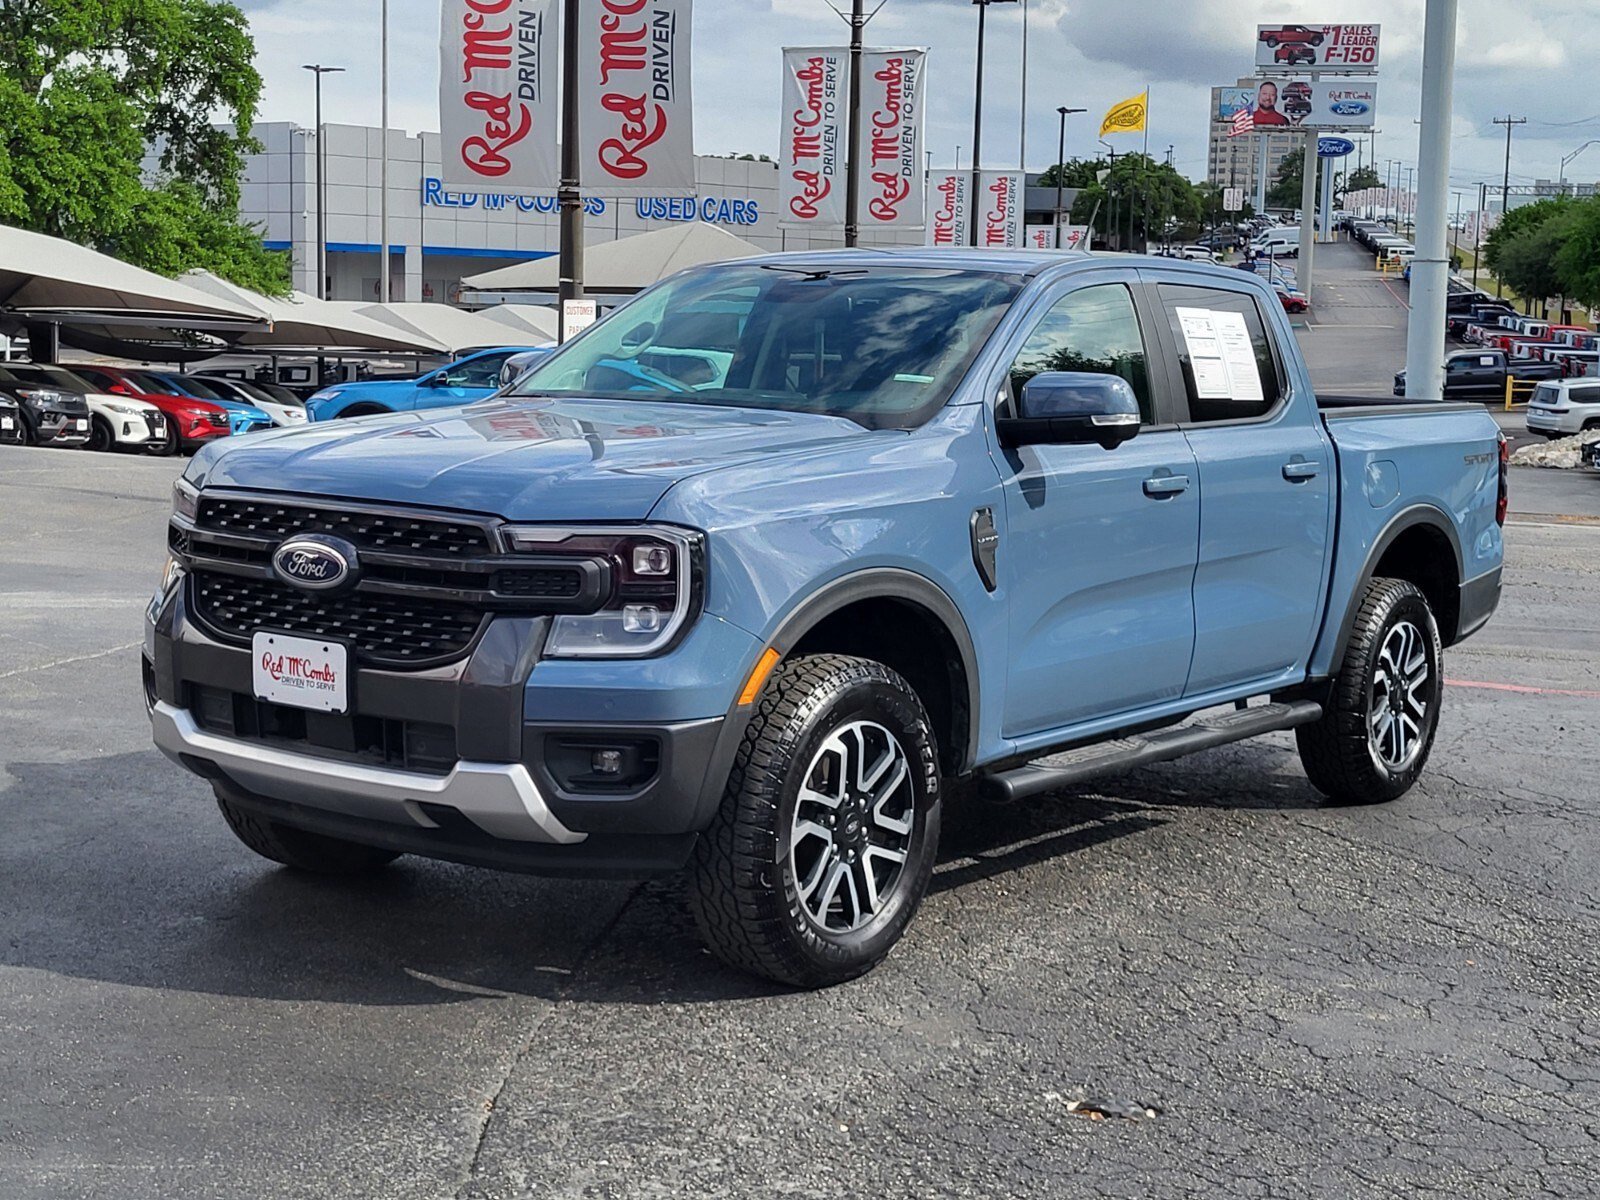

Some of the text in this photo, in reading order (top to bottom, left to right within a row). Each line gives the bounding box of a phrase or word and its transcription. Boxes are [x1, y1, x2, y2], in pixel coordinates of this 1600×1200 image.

[518, 10, 536, 101] DRIVEN
[653, 9, 670, 102] DRIVEN
[1322, 25, 1372, 46] #1 SALES
[1324, 47, 1375, 63] F-150
[1341, 36, 1378, 46] LEADER
[461, 91, 532, 177] Red
[598, 93, 667, 179] Red
[790, 57, 831, 219] Red McCombs
[823, 57, 837, 176] DRIVEN TO SERVE
[869, 58, 910, 221] Red McCombs
[902, 59, 915, 177] DRIVEN TO SERVE
[1318, 140, 1346, 153] Ford
[425, 178, 478, 206] RED
[639, 197, 697, 220] USED
[703, 197, 759, 224] CARS
[934, 176, 956, 247] McCombs
[955, 176, 965, 247] RIVEN TO SERVE
[986, 176, 1008, 247] McCombs
[1006, 176, 1017, 248] RIVEN TO SERVE
[566, 305, 593, 316] CUSTOMER
[287, 550, 327, 578] Ford
[262, 651, 336, 683] Red McCombs
[281, 675, 336, 692] DRIVEN TO SERVE
